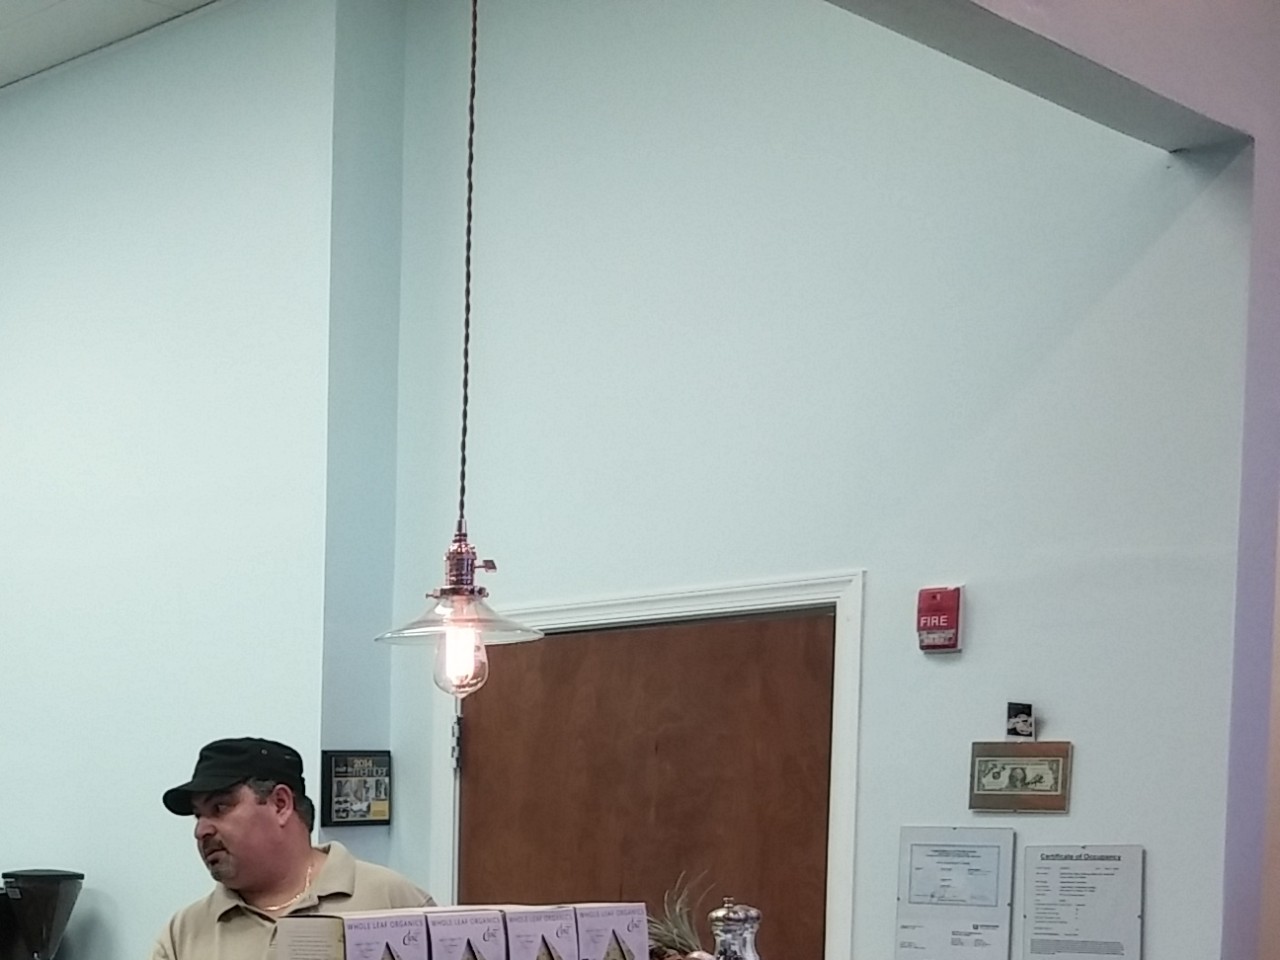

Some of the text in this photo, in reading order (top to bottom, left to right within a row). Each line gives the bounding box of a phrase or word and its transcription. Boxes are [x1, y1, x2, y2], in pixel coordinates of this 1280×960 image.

[920, 615, 948, 627] FIRE
[353, 759, 373, 768] 2014
[1040, 853, 1121, 862] Certificate of Occupancy
[347, 920, 423, 930] WHOLE LEAF ORGANICS
[469, 917, 500, 925] ORGANICS
